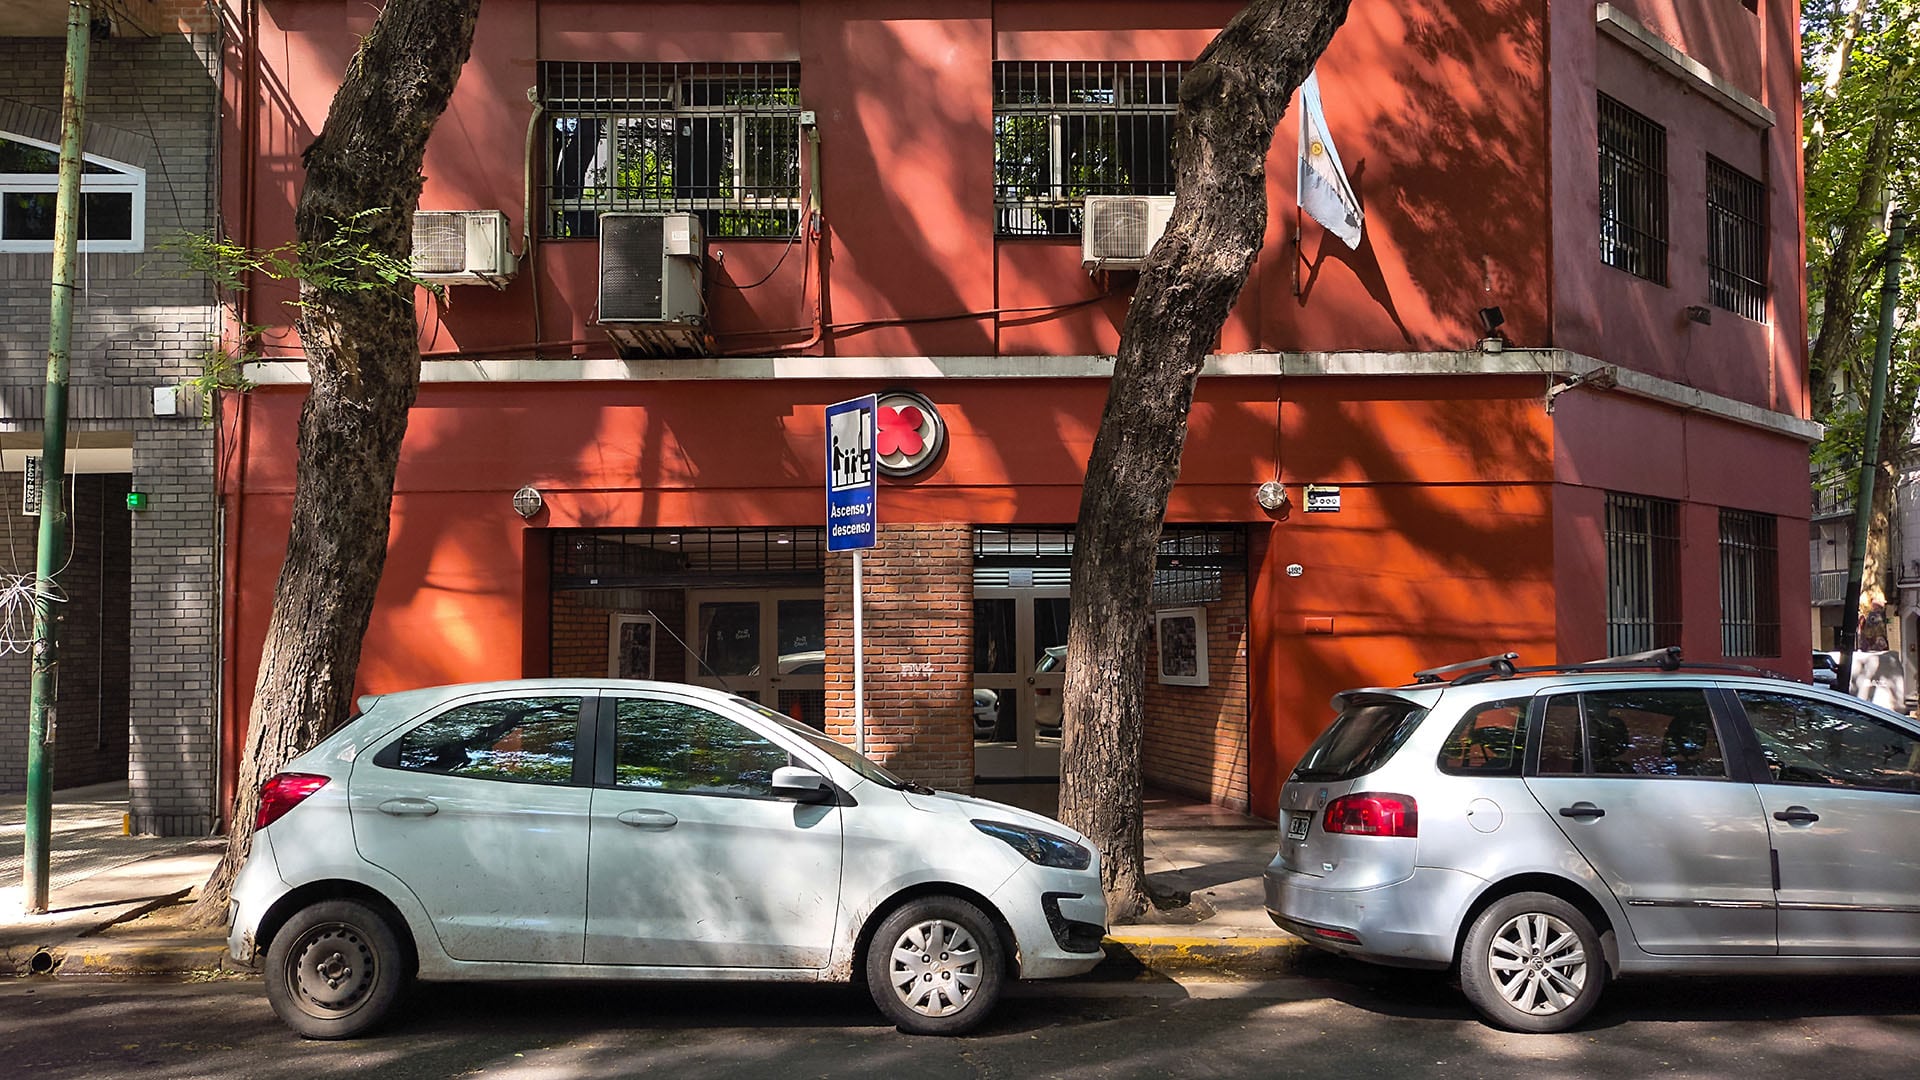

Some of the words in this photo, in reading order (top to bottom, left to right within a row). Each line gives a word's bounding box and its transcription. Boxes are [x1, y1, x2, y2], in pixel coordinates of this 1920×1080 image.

[831, 503, 865, 518] Ascenso
[866, 502, 872, 516] y
[832, 522, 870, 536] descenso
